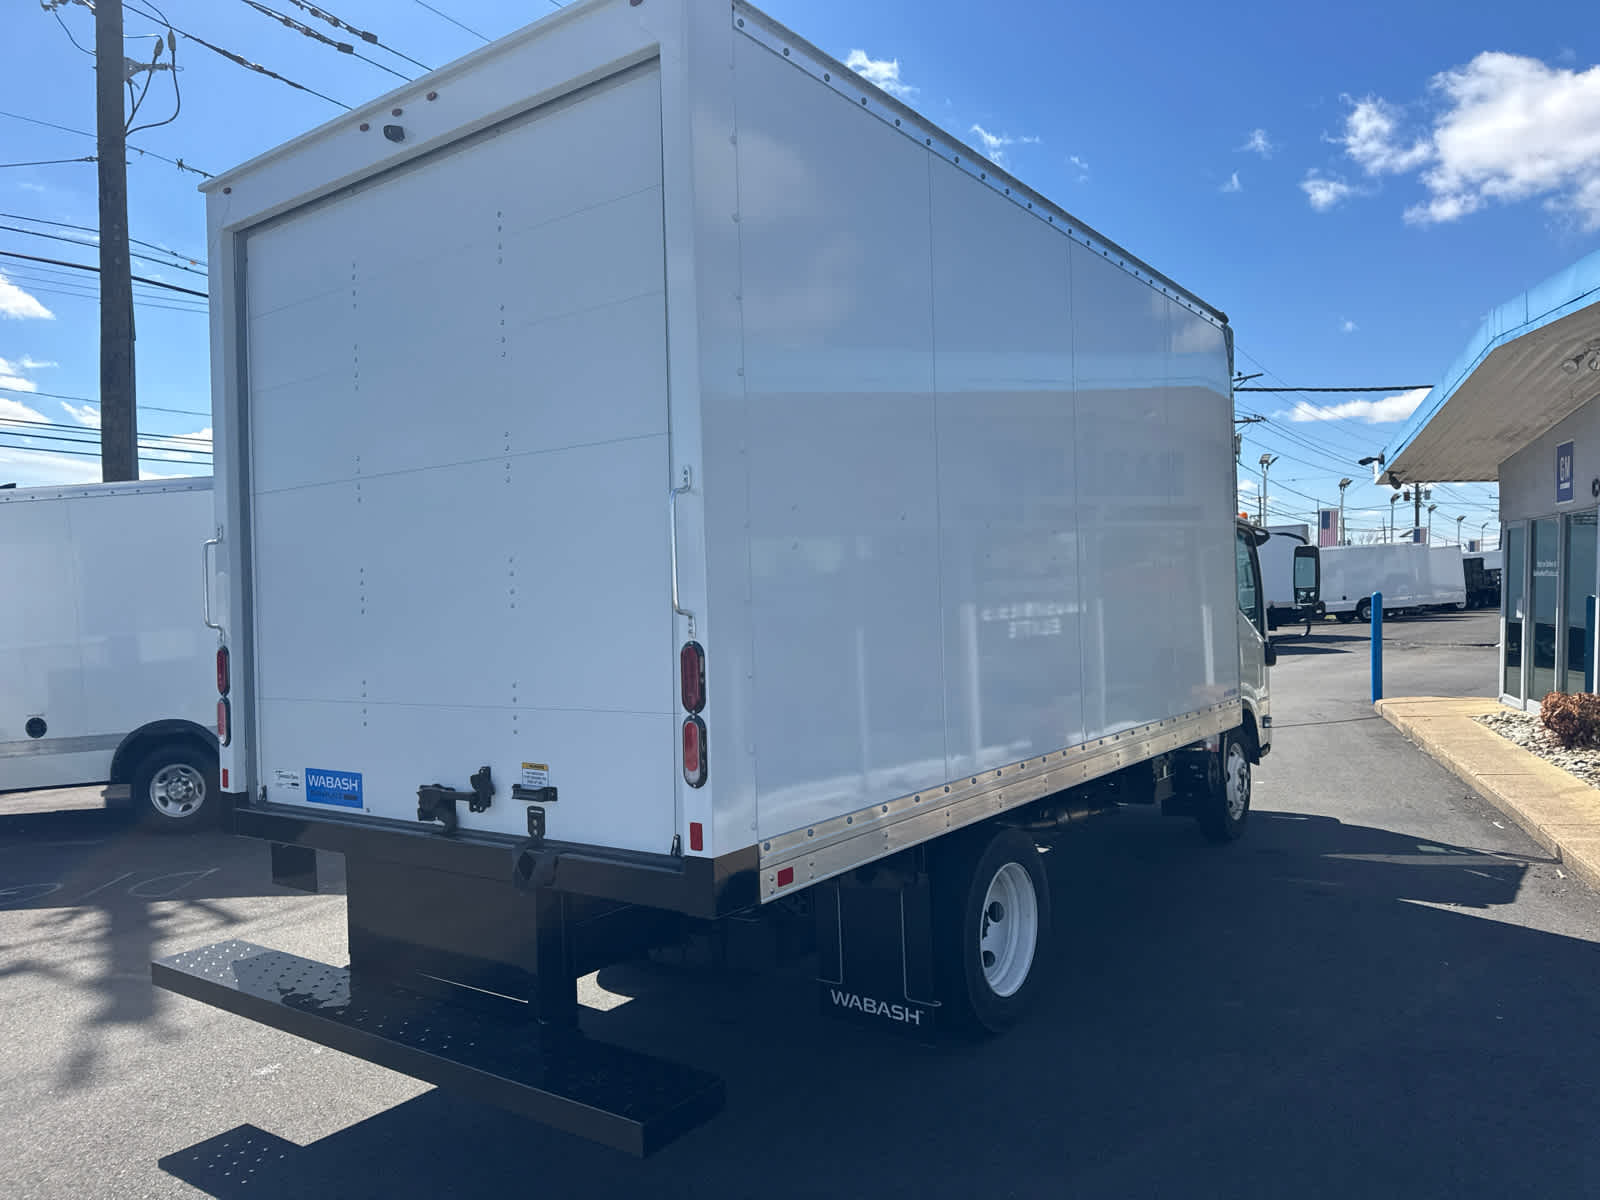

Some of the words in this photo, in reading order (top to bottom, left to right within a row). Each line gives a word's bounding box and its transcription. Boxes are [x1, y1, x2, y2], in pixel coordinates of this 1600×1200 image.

[1560, 455, 1571, 481] GM
[308, 774, 359, 792] WABASH
[830, 988, 921, 1025] WABASH
